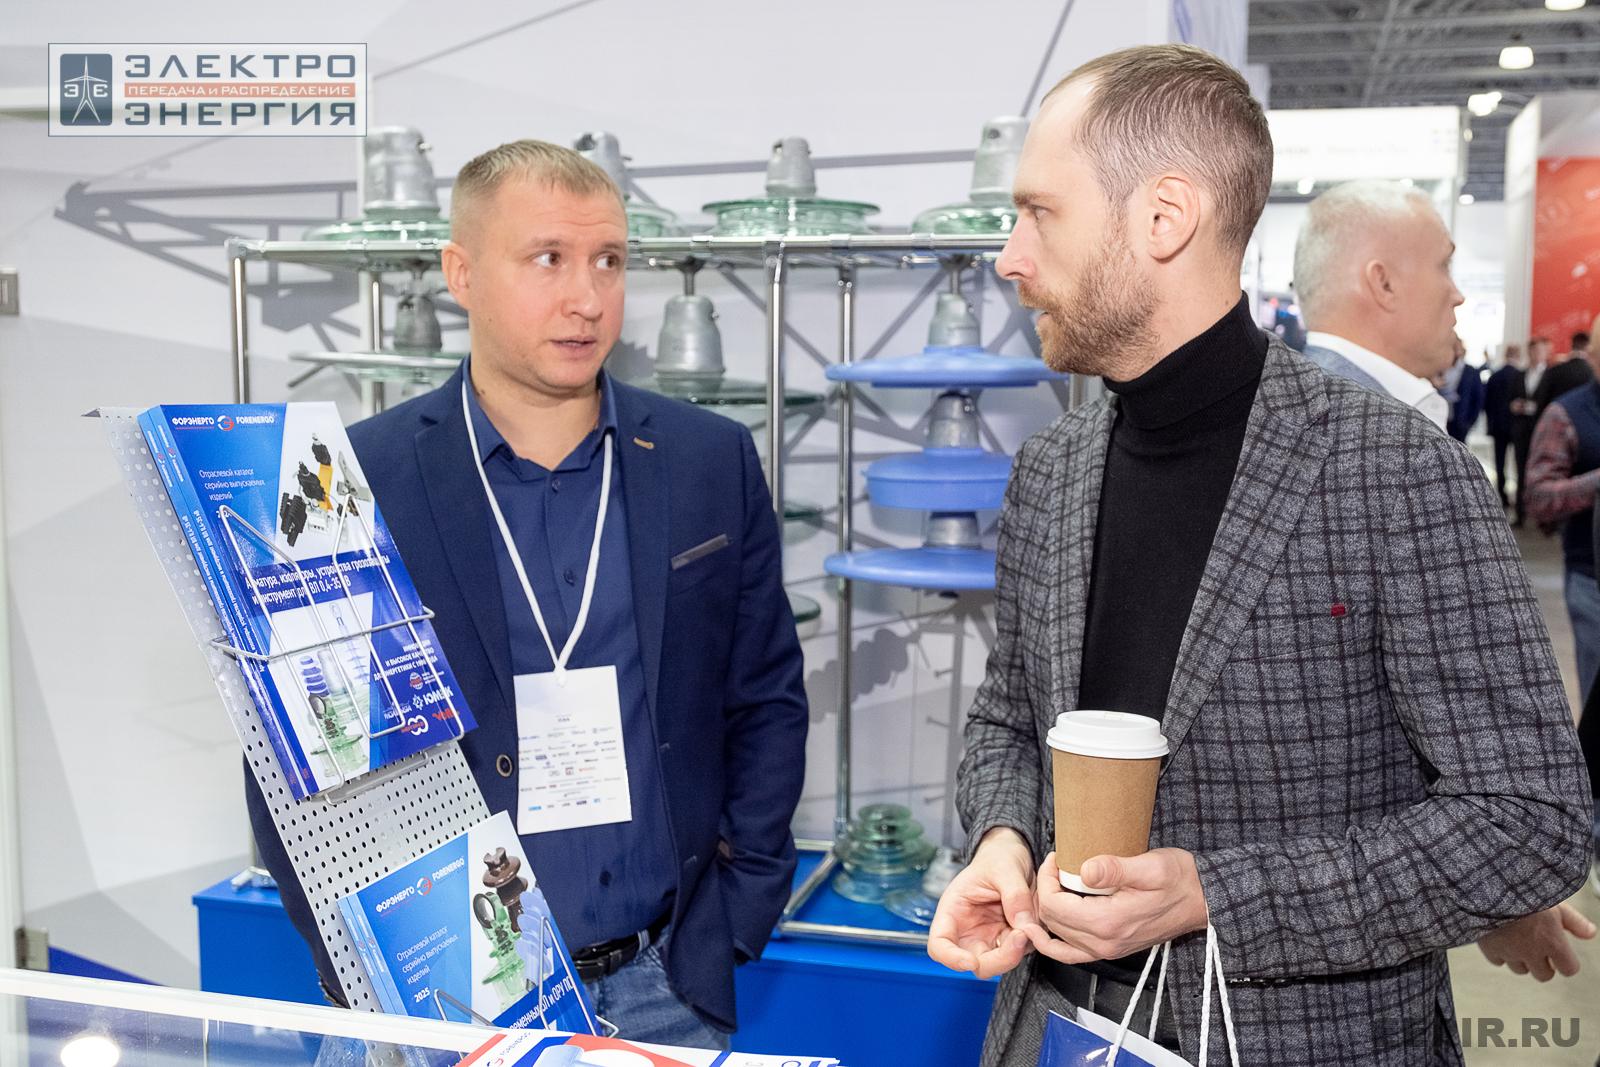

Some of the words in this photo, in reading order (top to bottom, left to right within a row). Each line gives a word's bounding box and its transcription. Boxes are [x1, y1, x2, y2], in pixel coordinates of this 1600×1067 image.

[172, 416, 215, 426] ФОРЭНЕРГО
[235, 415, 275, 424] FORENERGO
[199, 468, 233, 479] Отраслевой
[204, 480, 229, 490] серийно
[209, 491, 234, 501] изделий
[245, 575, 280, 589] Аматура,
[259, 588, 297, 604] нструмент
[308, 581, 320, 594] ВЛ
[319, 576, 341, 592] 0,4-35
[432, 857, 465, 881] FORENERGO
[376, 886, 415, 913] ФОРЭНЕРГО
[397, 935, 430, 961] Отраслевой
[429, 926, 449, 943] каталог
[402, 954, 427, 974] серийно
[407, 964, 431, 985] изделий
[414, 986, 431, 1003] 2025
[552, 982, 565, 1001] ОРУ
